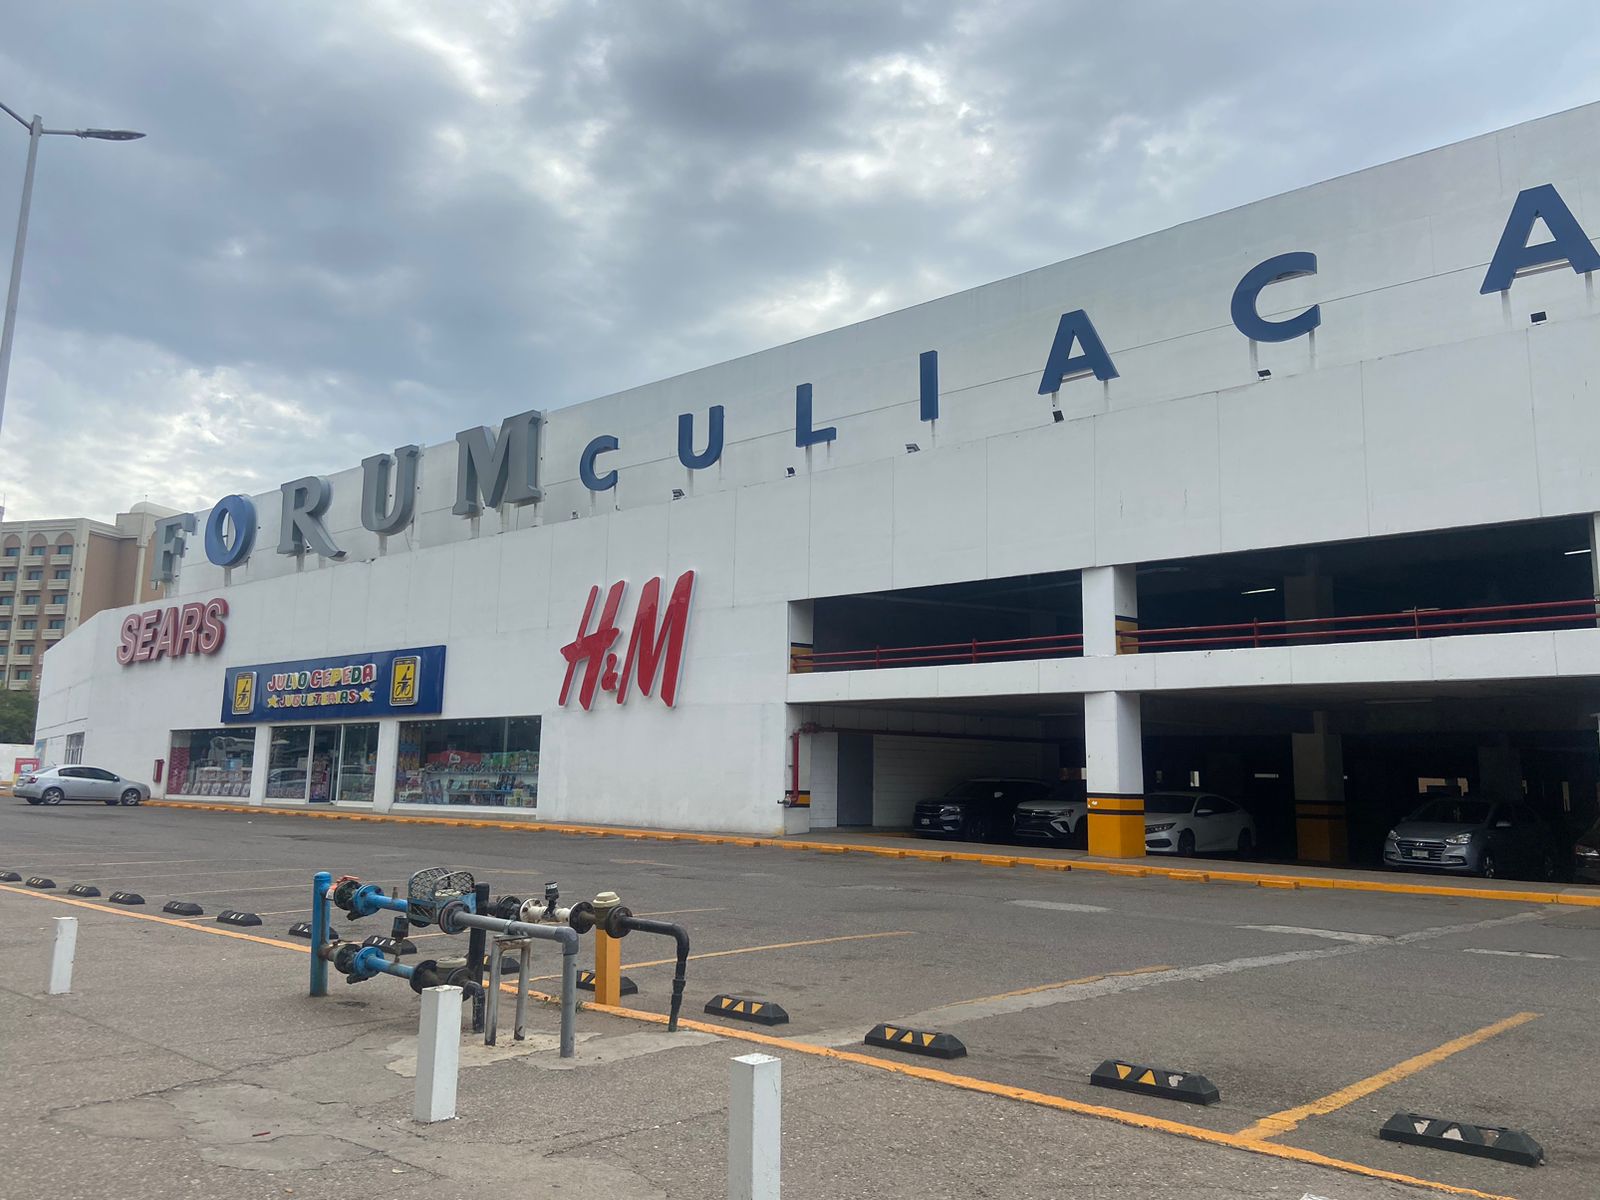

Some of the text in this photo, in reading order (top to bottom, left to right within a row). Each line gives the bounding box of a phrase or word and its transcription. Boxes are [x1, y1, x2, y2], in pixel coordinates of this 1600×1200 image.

[151, 183, 1600, 583] FORUM CULIACA
[117, 598, 228, 665] SEARS
[267, 663, 376, 692] JULIO CEPEDA
[558, 569, 696, 711] H&M
